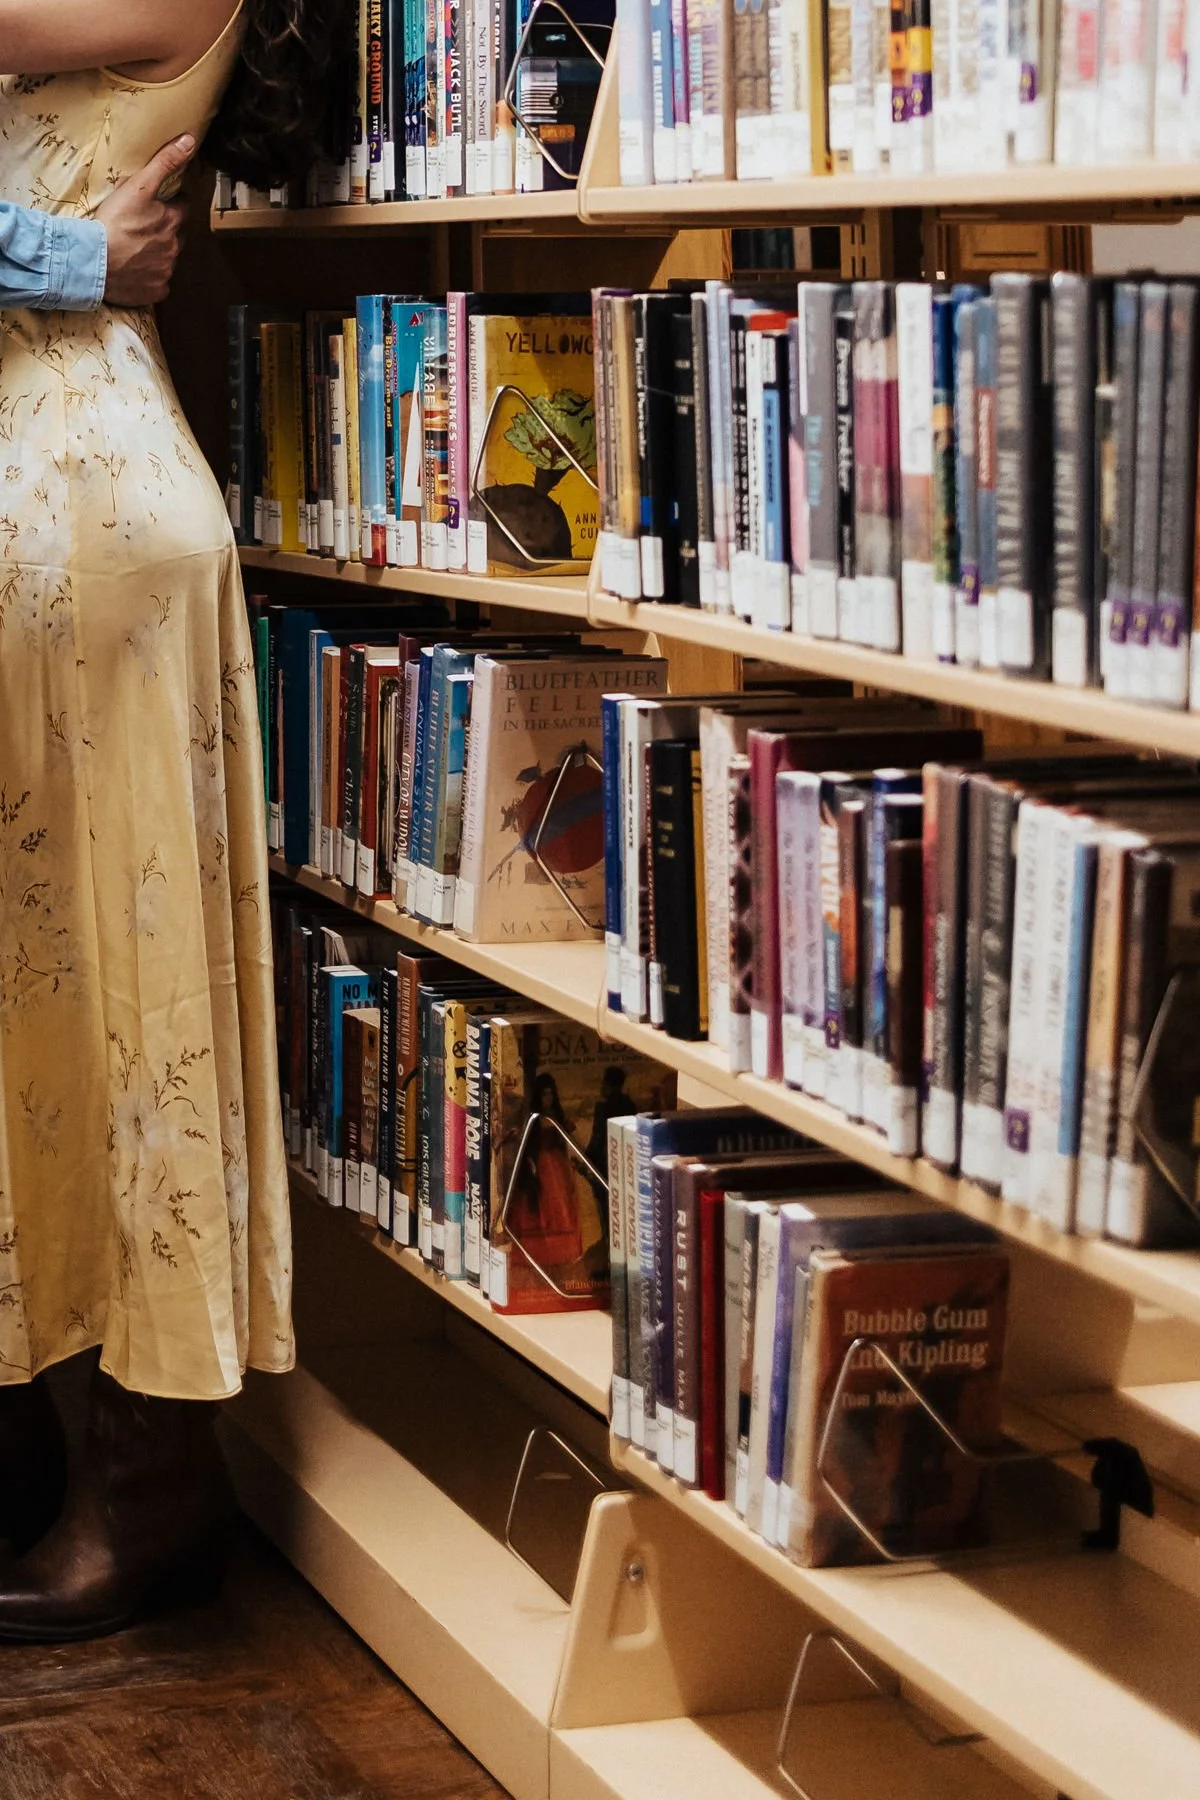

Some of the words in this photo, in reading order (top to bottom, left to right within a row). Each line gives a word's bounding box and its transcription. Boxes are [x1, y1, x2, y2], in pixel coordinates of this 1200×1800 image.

[479, 26, 487, 48] Not
[370, 40, 382, 105] GROUND
[450, 48, 462, 89] JACK
[476, 55, 487, 74] By
[478, 75, 487, 96] The
[478, 100, 487, 136] Sword
[384, 334, 393, 356] Big
[469, 321, 477, 347] ANN
[385, 359, 393, 404] Dreams
[448, 301, 458, 442] BORDERSNAKES
[469, 348, 478, 401] CUMMINS
[385, 406, 393, 429] and
[574, 512, 597, 525] ANN
[505, 669, 658, 691] BLUEFEATHER
[349, 682, 360, 738] SANDRA
[503, 718, 519, 731] IN
[524, 717, 547, 730] THE
[414, 699, 425, 778] ANIMAL
[424, 689, 440, 813] BLUEFEATHER
[343, 767, 355, 806] Chili
[401, 751, 412, 787] CITY
[400, 786, 411, 805] OF
[398, 808, 410, 859] WIDOW
[500, 919, 552, 934] MAX
[342, 983, 361, 1001] NO
[382, 1007, 390, 1083] SUMMONING
[465, 1022, 481, 1109] BANANA
[396, 1087, 407, 1109] THE
[395, 1112, 407, 1168] VISITANT
[422, 1134, 430, 1160] LOIS
[464, 1113, 481, 1161] ROSE
[610, 1136, 619, 1181] DUST
[626, 1143, 636, 1187] DUST
[611, 1187, 621, 1250] DEVILS
[628, 1194, 637, 1258] DEVILS
[654, 1178, 663, 1249] FINDING
[676, 1209, 688, 1292] RUST
[676, 1302, 685, 1359] JULIE
[843, 1307, 928, 1335] Bubble
[933, 1305, 988, 1330] Gum
[897, 1339, 989, 1374] Kipling
